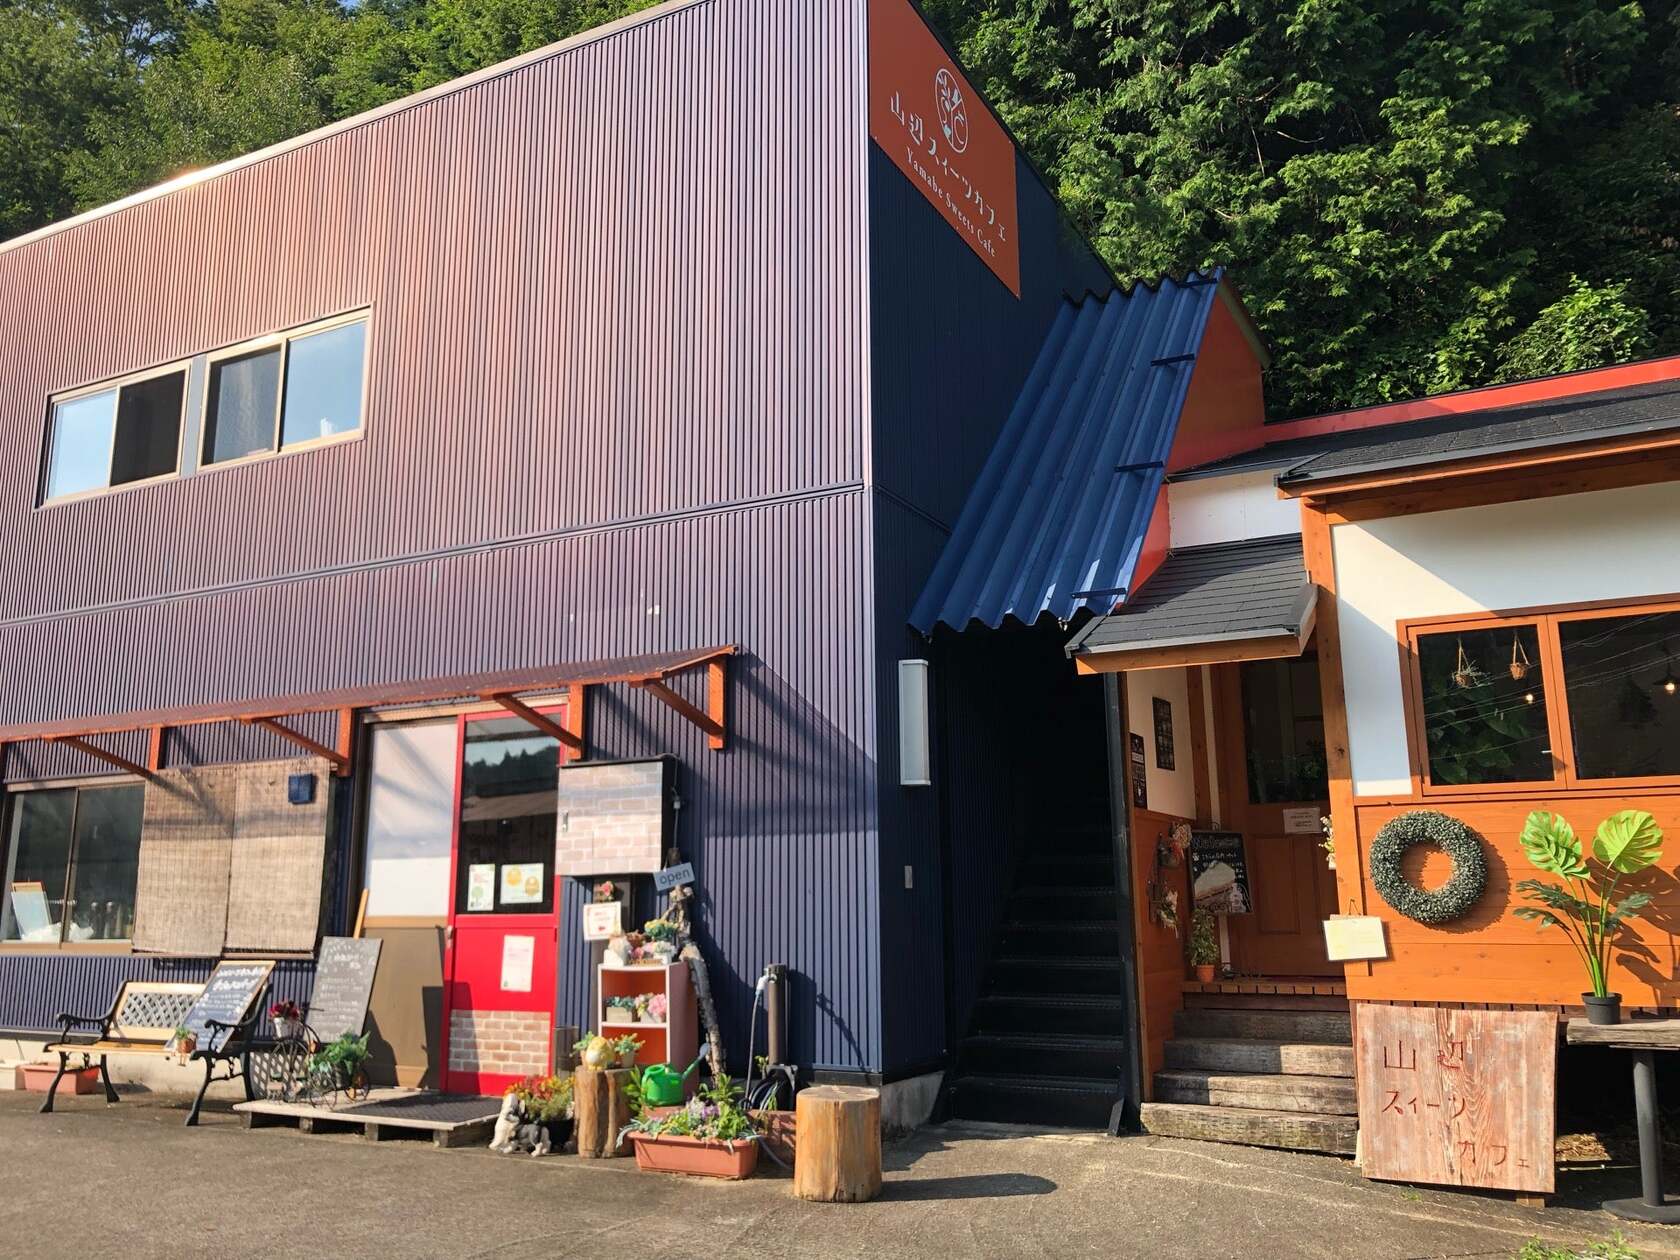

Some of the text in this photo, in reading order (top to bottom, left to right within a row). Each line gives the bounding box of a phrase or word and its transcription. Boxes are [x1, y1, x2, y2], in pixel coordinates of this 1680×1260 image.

[906, 145, 996, 257] Yamabe Sweets Cafe
[659, 869, 691, 886] open
[1456, 1140, 1531, 1169] カフェ
